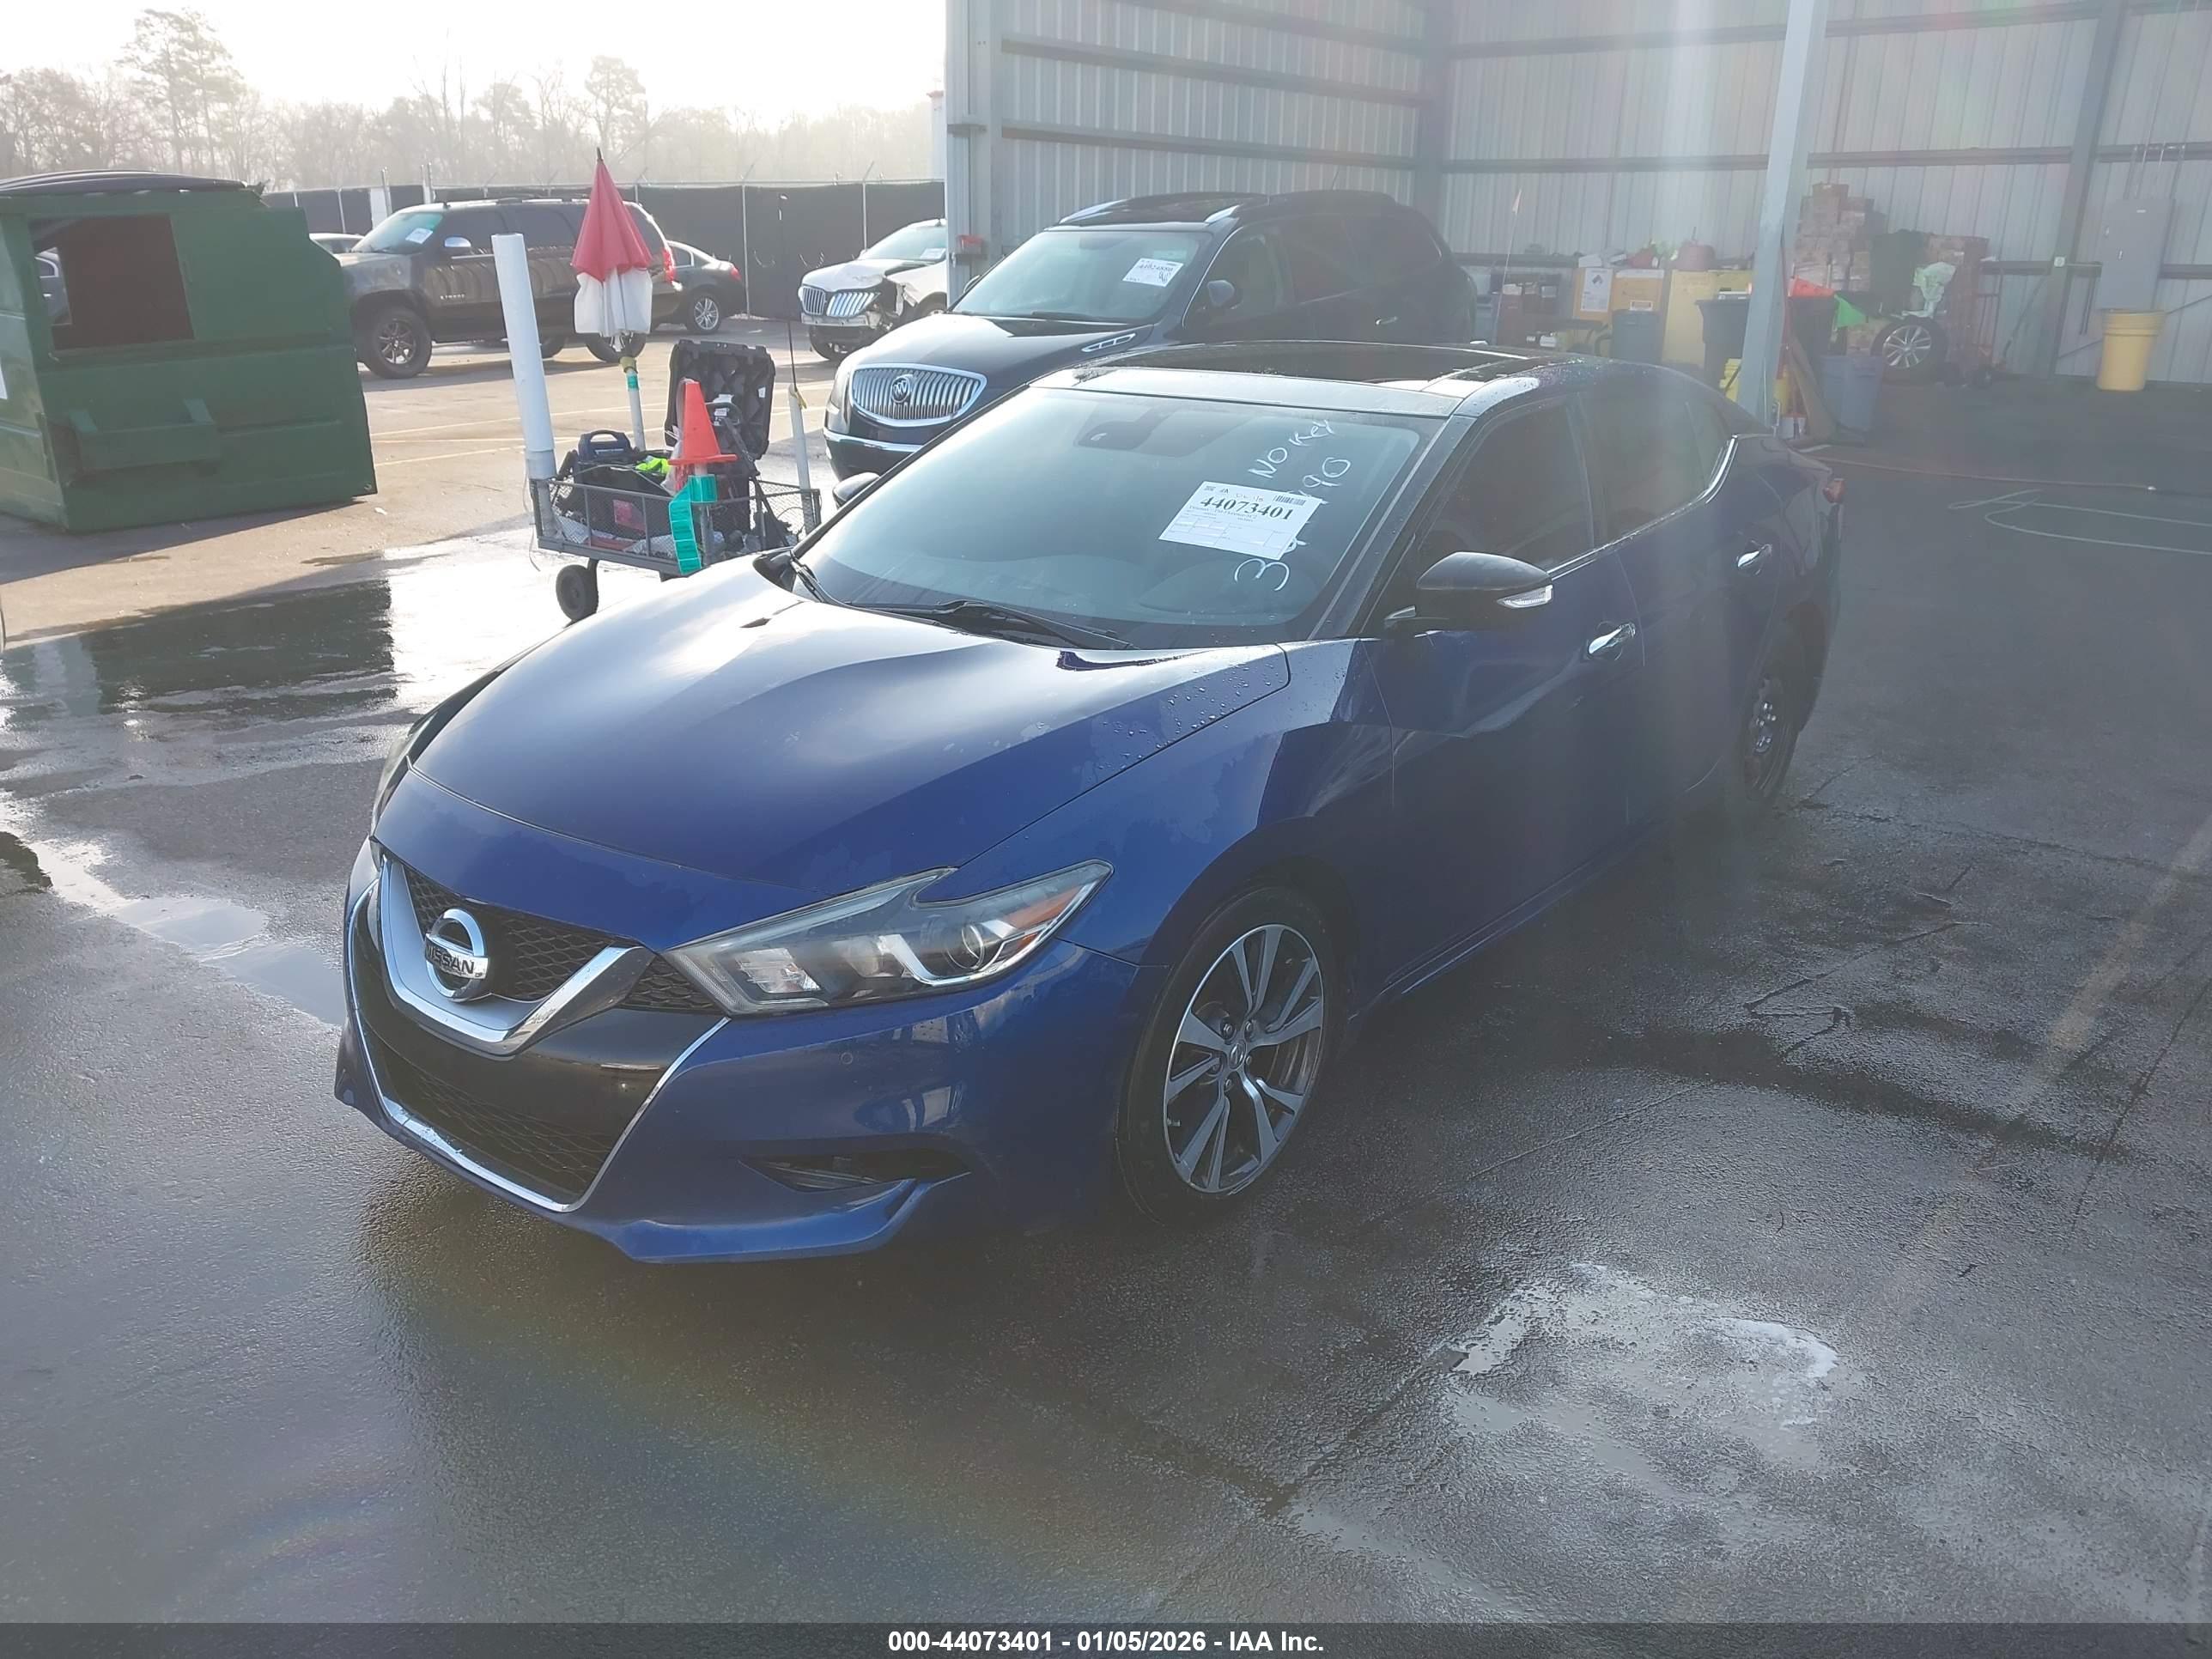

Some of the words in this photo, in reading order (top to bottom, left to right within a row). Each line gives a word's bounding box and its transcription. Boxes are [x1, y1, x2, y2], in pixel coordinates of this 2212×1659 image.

[1248, 447, 1288, 479] NO
[1200, 495, 1294, 520] 44073401
[427, 945, 475, 975] NISSAN
